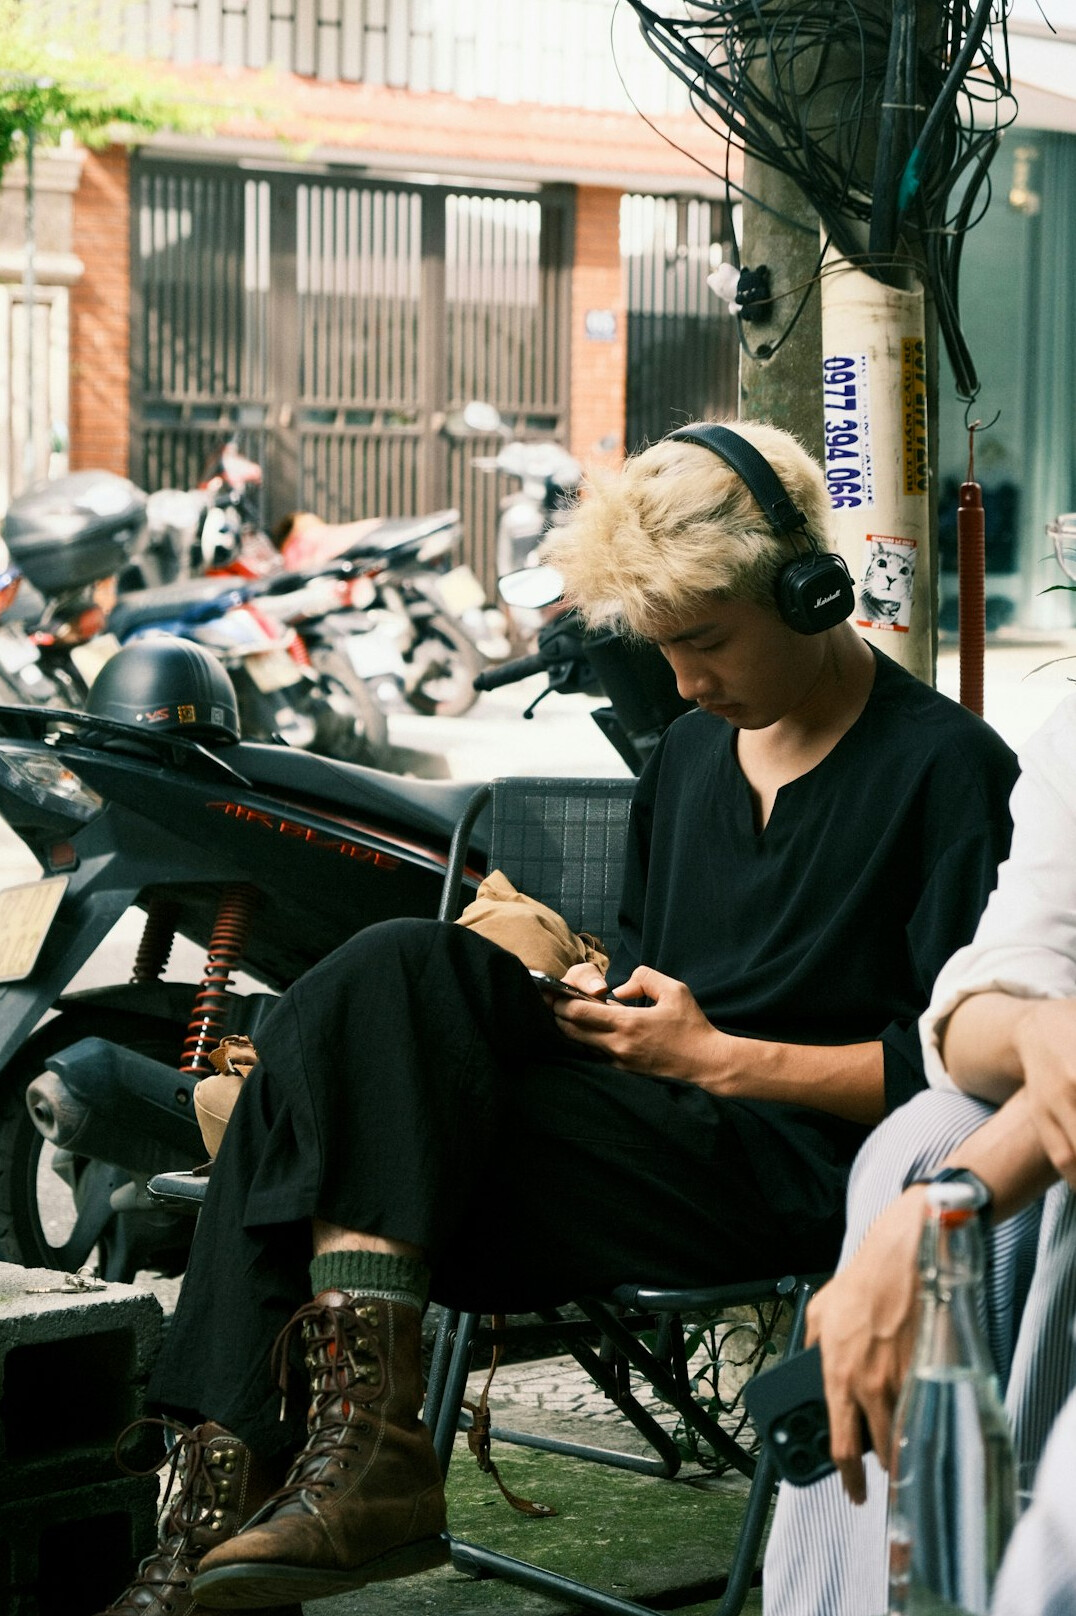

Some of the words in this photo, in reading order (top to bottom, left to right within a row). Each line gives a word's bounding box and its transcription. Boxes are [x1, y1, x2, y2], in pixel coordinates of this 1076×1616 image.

[824, 356, 857, 411] 0977
[825, 419, 859, 462] 394
[827, 467, 862, 510] 066
[814, 589, 841, 608] Marshall
